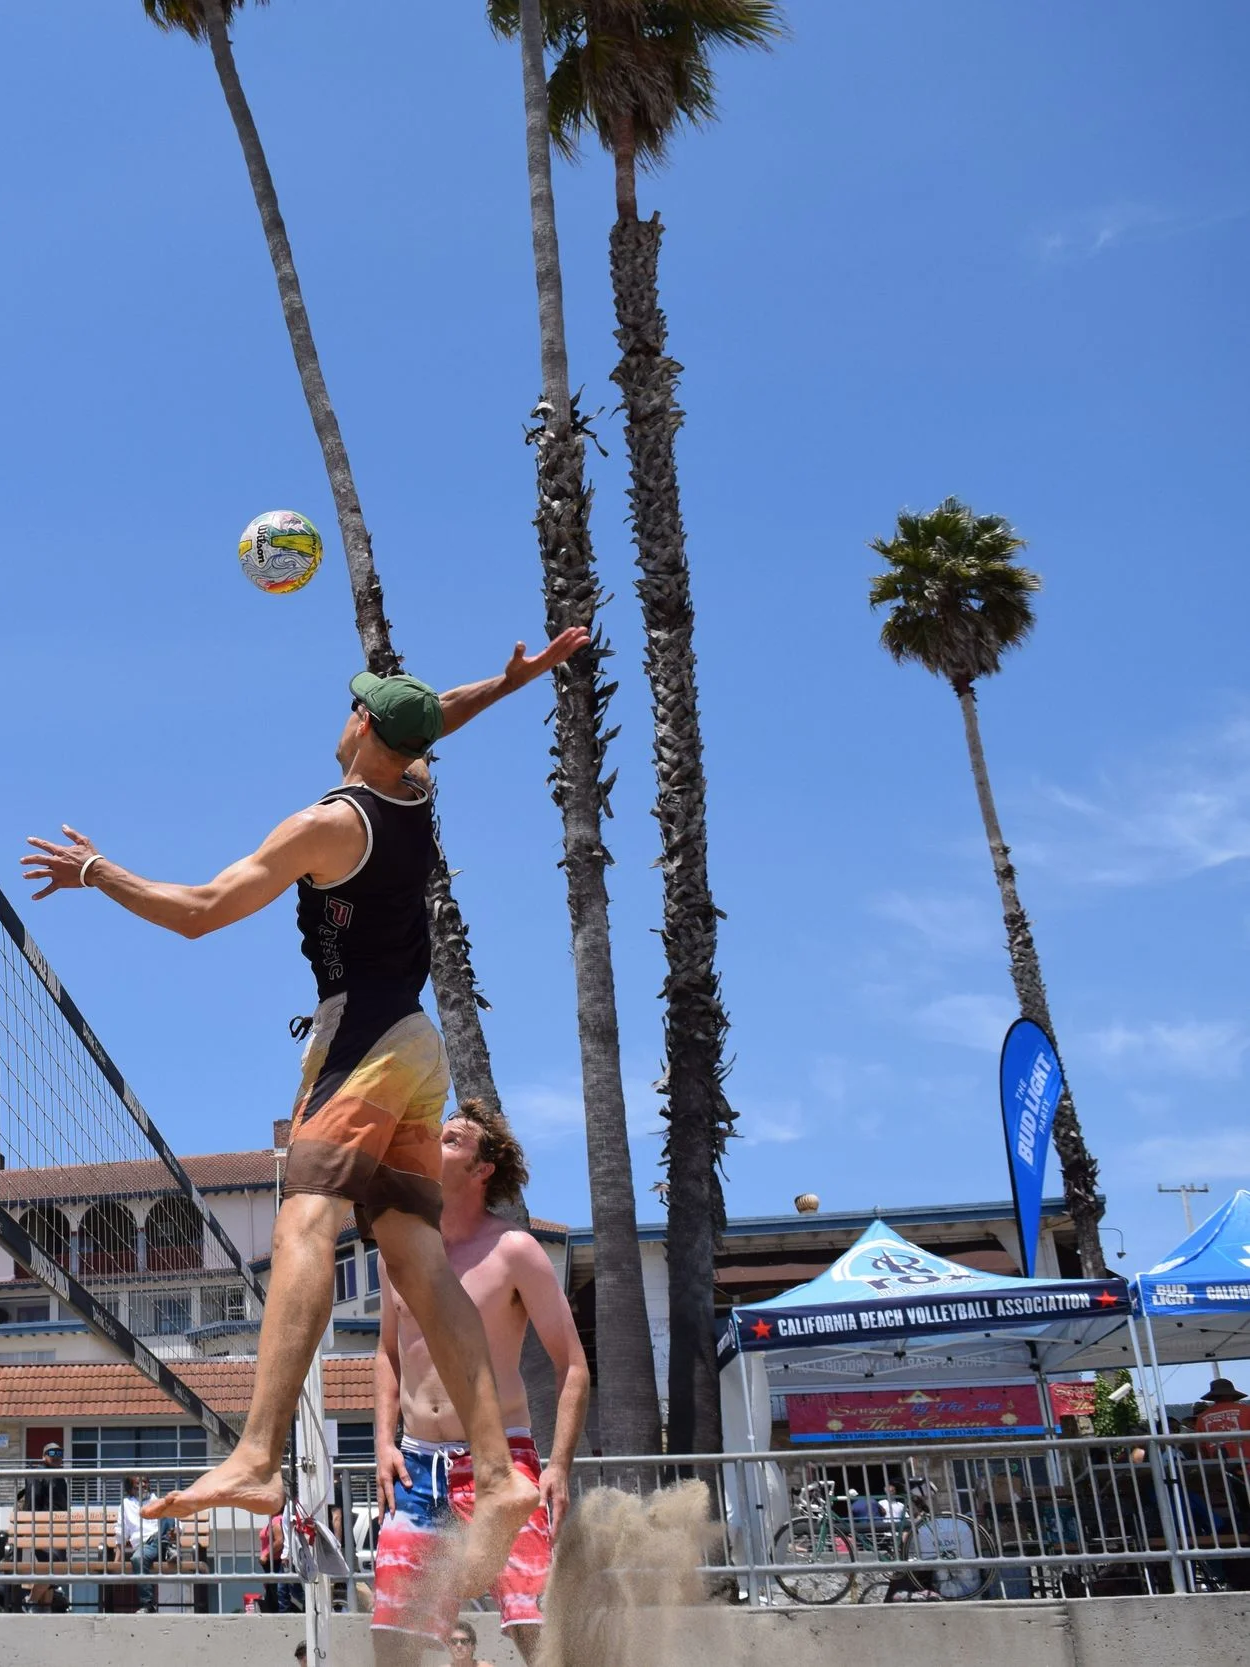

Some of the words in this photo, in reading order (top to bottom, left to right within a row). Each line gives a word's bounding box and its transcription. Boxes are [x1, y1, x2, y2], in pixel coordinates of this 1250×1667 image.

[256, 525, 267, 564] Wilson
[1015, 1078, 1028, 1100] THE
[1024, 1052, 1052, 1115] LIGHT
[1038, 1098, 1051, 1135] PARTY
[1017, 1110, 1037, 1166] BUD
[1152, 1294, 1195, 1305] LIGHT
[1155, 1284, 1188, 1295] BUD
[777, 1316, 858, 1337] CALIFORNIA
[860, 1308, 904, 1329] BEACH
[907, 1300, 993, 1324] VOLLEYBALL
[996, 1293, 1091, 1317] ASSOCIATION
